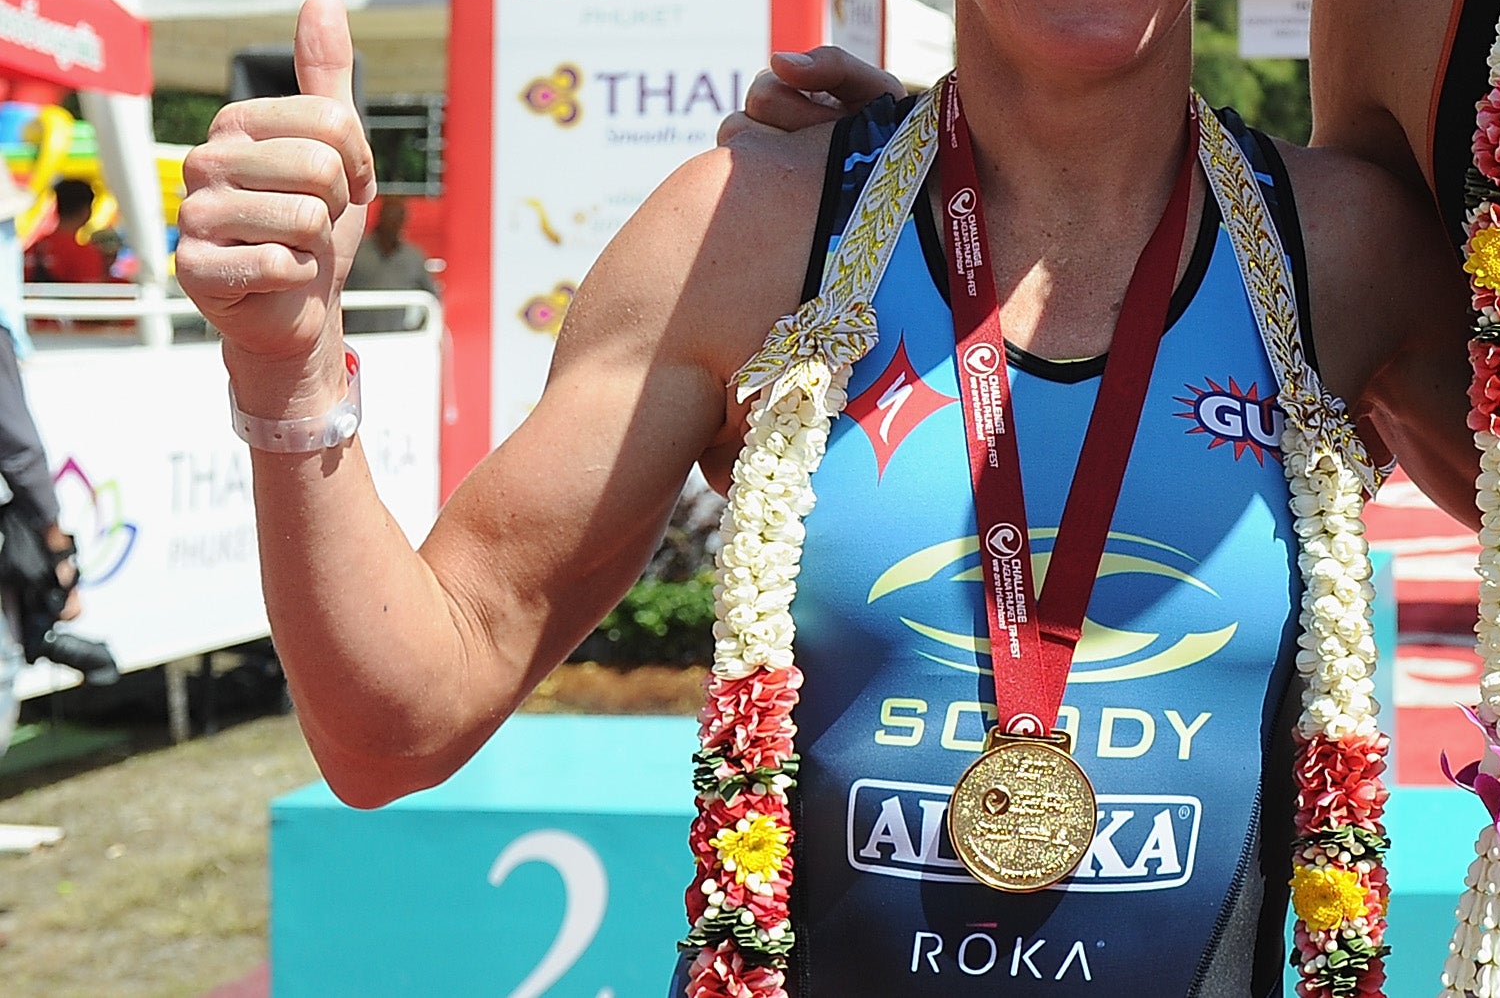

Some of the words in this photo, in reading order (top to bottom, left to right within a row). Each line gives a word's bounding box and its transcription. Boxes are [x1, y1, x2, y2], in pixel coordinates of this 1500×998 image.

[1199, 396, 1284, 447] GU
[874, 698, 1212, 761] SCDY
[859, 795, 1182, 879] ALKA
[487, 828, 614, 998] 2
